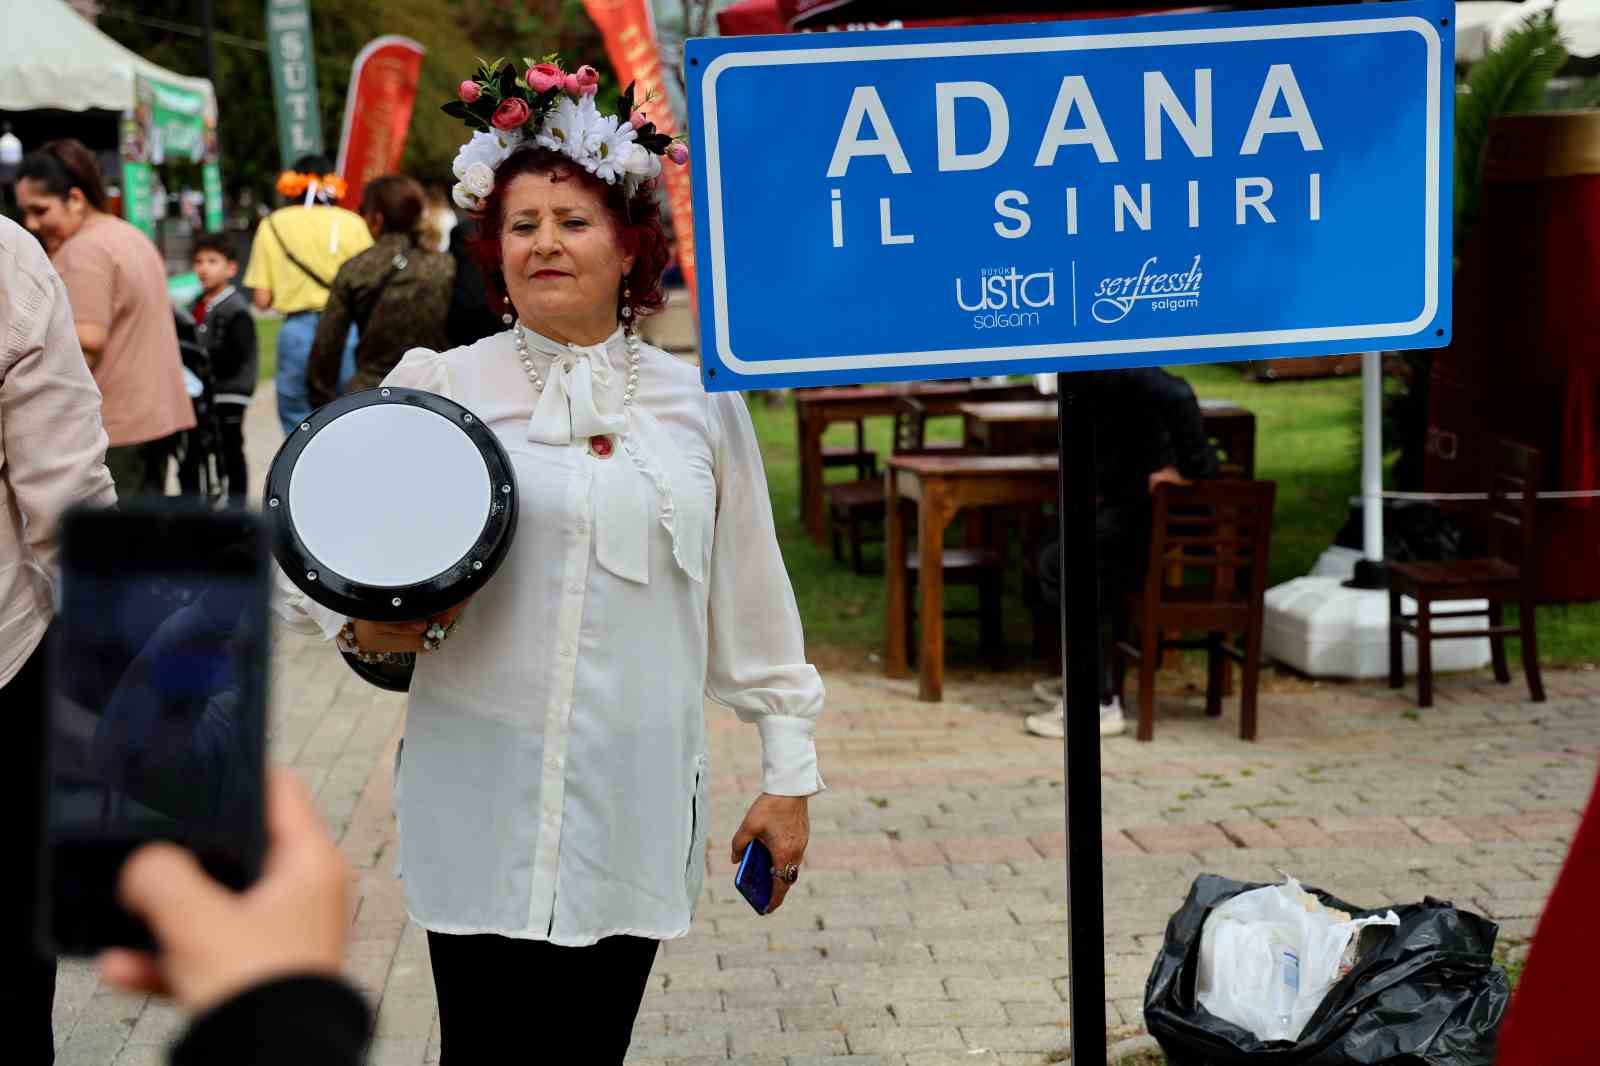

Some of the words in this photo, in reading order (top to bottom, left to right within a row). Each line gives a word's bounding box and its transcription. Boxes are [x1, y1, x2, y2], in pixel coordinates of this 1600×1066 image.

[826, 64, 1324, 178] ADANA
[831, 188, 915, 248] İL
[993, 173, 1321, 240] SINIRI
[956, 266, 1055, 312] usta
